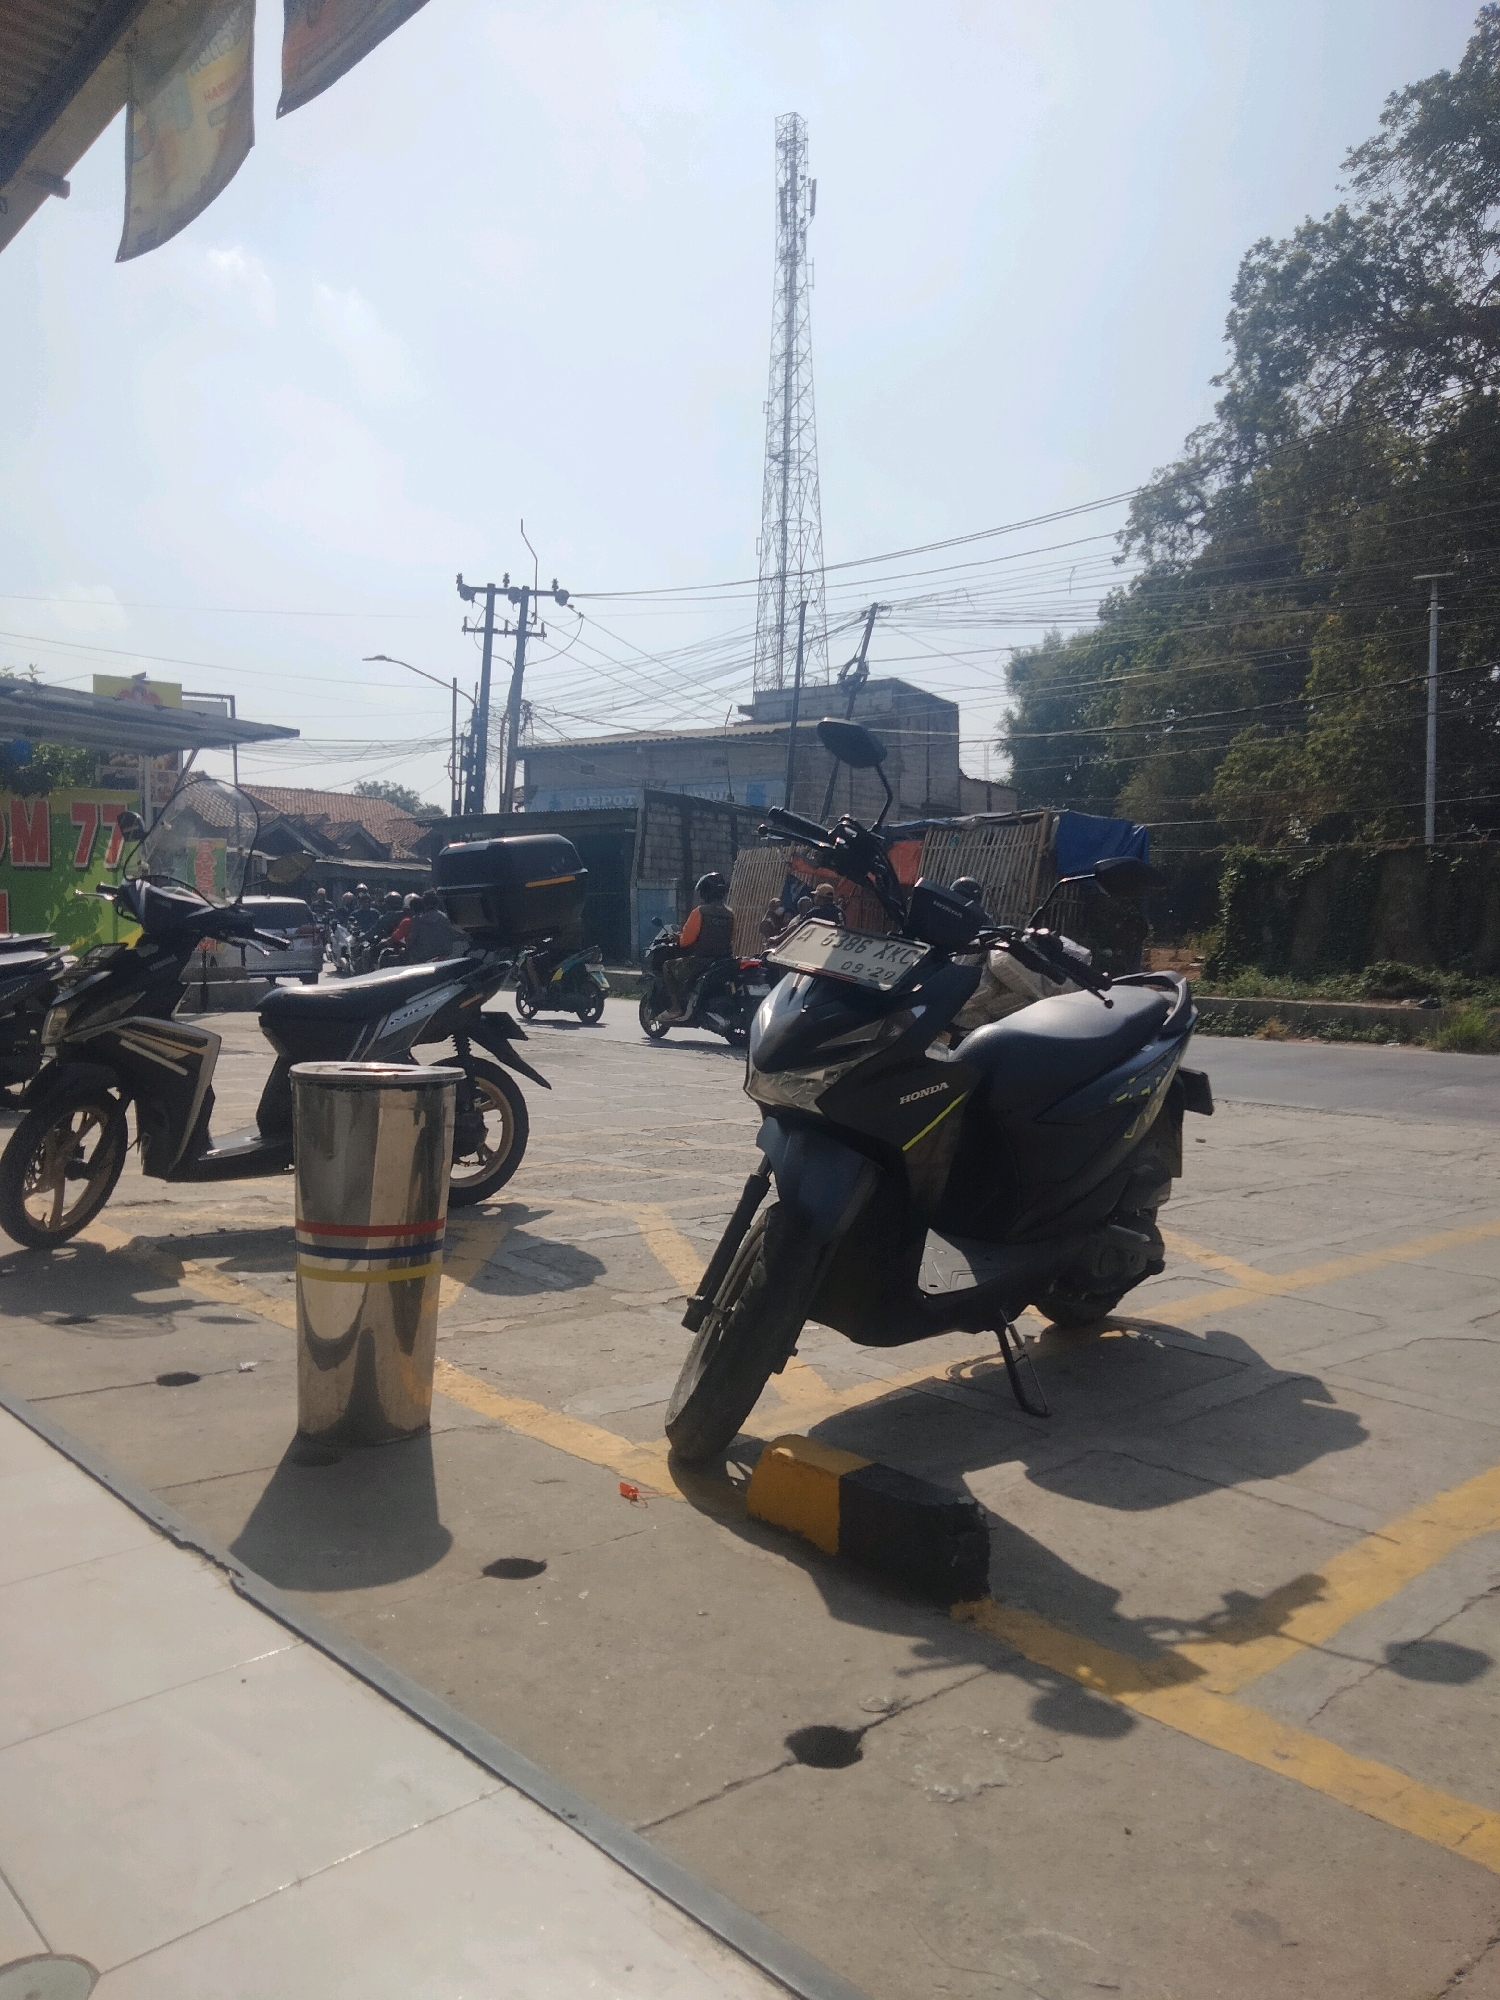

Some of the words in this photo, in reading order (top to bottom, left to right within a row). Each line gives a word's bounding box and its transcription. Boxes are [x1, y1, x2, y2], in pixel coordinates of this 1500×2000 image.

[574, 794, 636, 807] DEPOT
[0, 799, 51, 868] M
[70, 801, 127, 868] 77
[873, 942, 919, 965] XKC
[900, 1081, 949, 1105] HONDA
